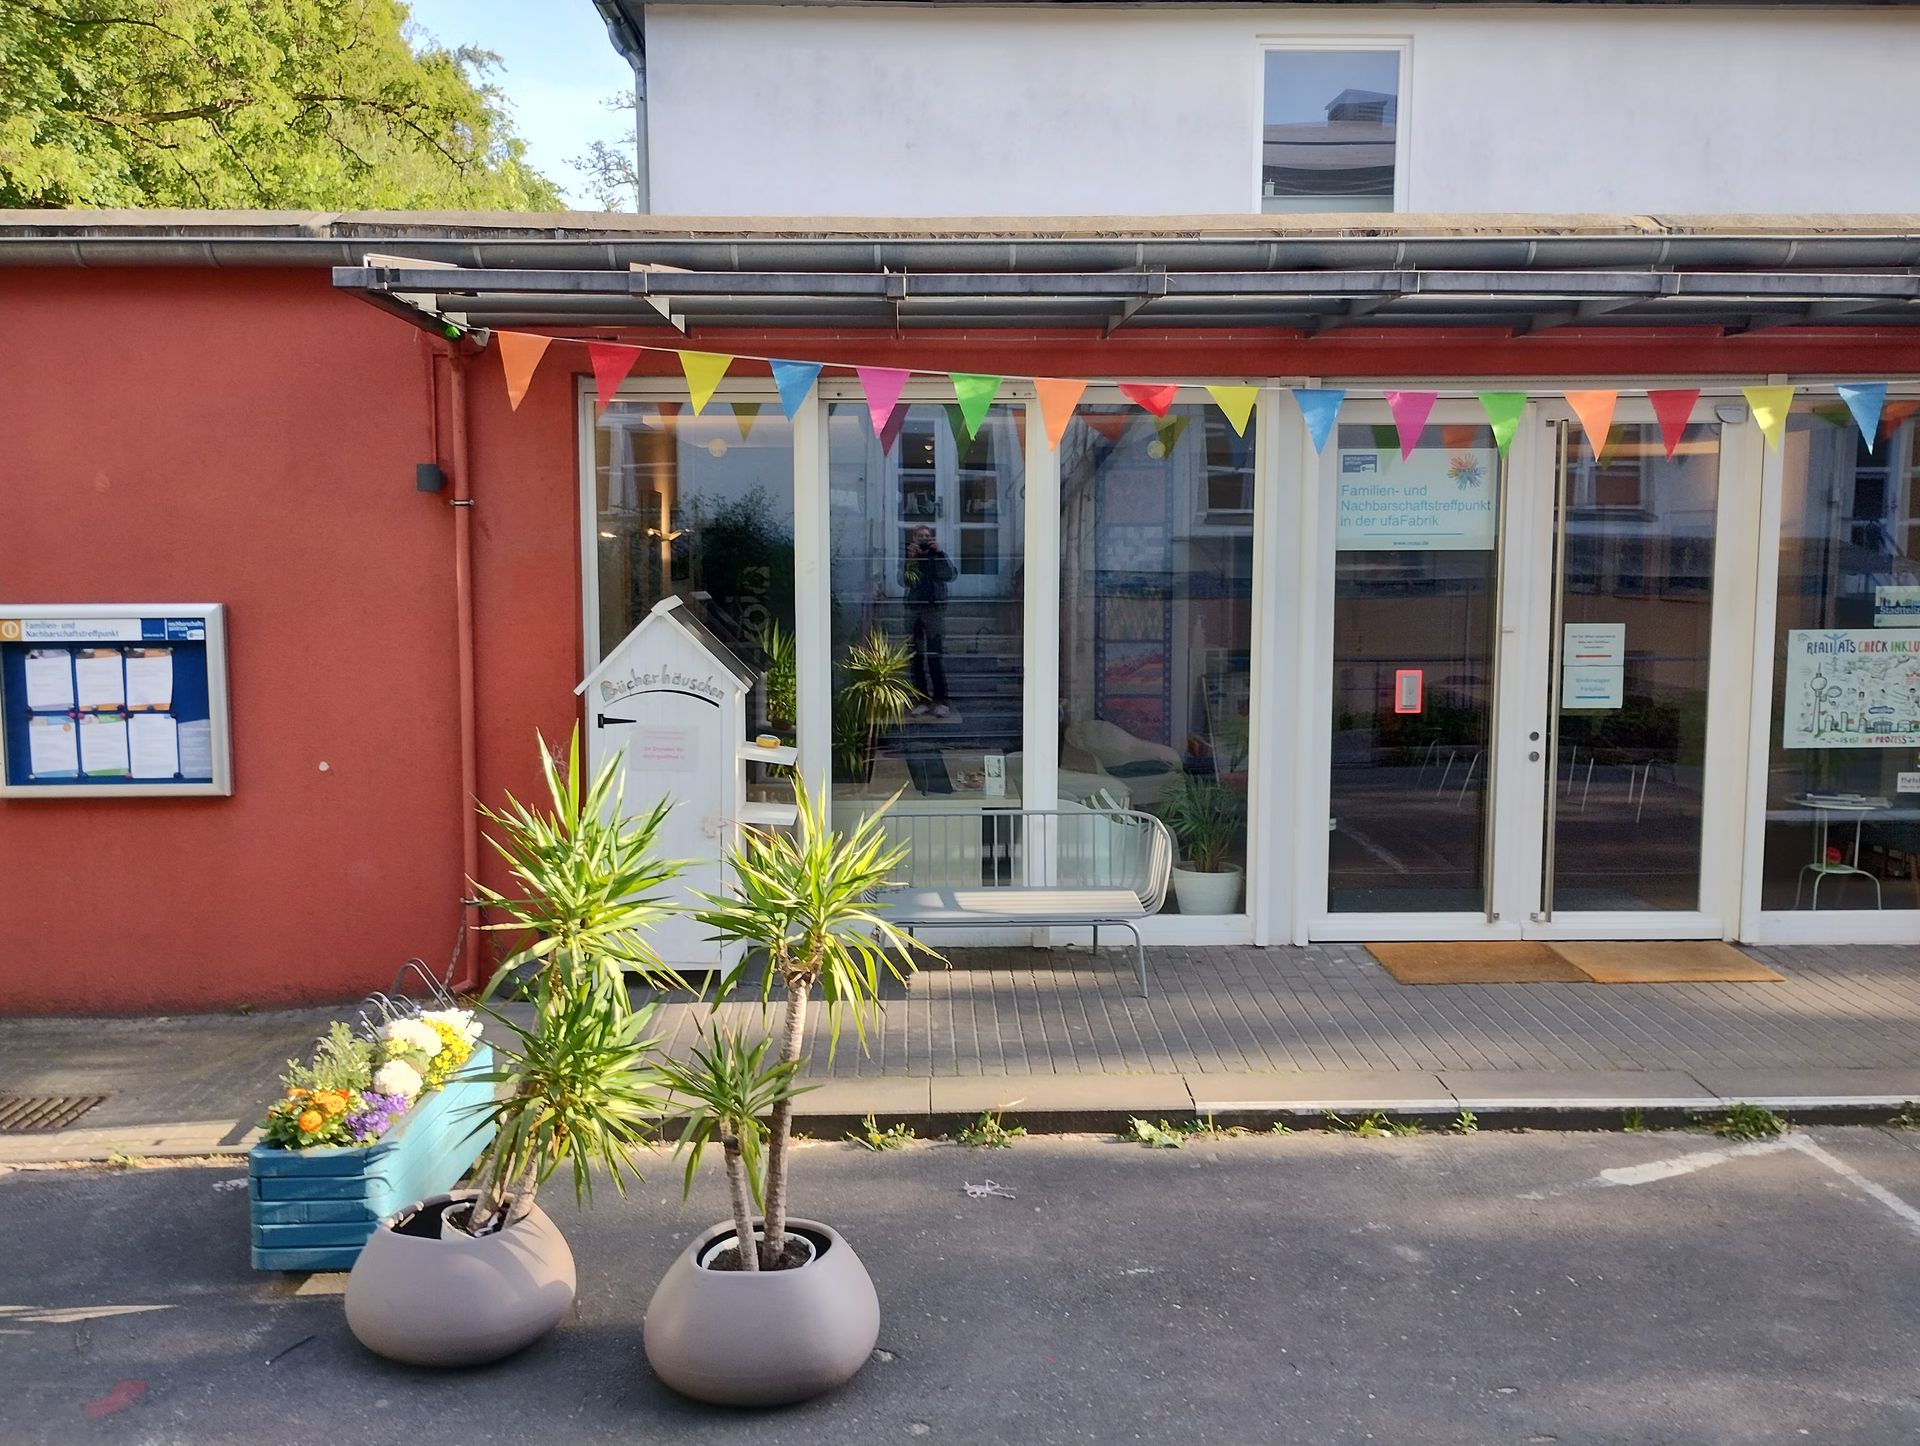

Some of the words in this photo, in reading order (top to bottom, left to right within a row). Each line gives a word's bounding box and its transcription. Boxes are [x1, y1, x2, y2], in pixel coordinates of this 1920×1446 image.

[1341, 485, 1399, 496] Familien-
[1404, 485, 1428, 496] und
[1340, 499, 1491, 513] Nachbarschaftstreffpunkt
[1340, 515, 1352, 527] in
[1355, 515, 1376, 527] der
[1380, 515, 1439, 527] ufaFabrik
[25, 621, 57, 629] Familien-
[61, 621, 76, 629] und
[1858, 639, 1888, 654] CHECK
[600, 664, 725, 702] Bücherhäuschen
